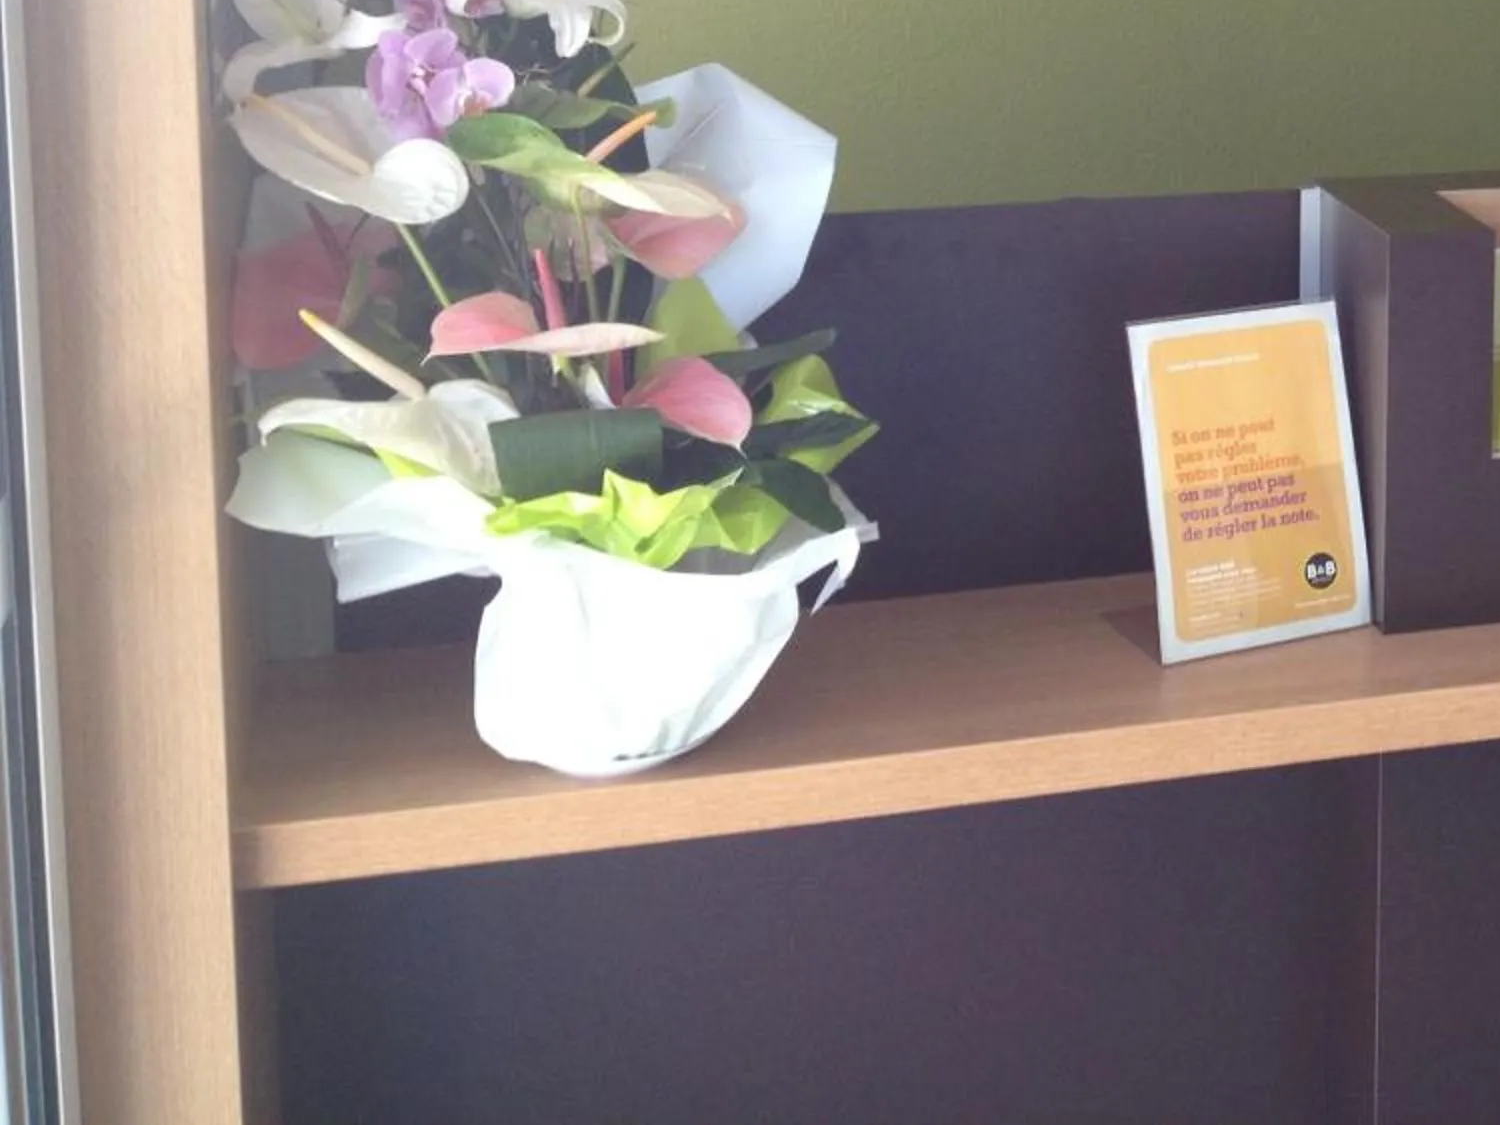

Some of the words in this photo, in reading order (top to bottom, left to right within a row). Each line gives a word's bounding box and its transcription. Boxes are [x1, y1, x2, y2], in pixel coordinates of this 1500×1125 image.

[1172, 430, 1187, 446] Si
[1190, 430, 1211, 443] on
[1216, 426, 1235, 439] ne
[1174, 450, 1204, 469] pas
[1178, 490, 1200, 503] on
[1203, 486, 1224, 500] ne
[1226, 477, 1264, 502] peut
[1267, 473, 1295, 493] pas
[1180, 507, 1219, 523] vous
[1223, 490, 1308, 515] demander
[1182, 526, 1203, 542] de
[1207, 518, 1257, 539] régler
[1261, 513, 1277, 529] la
[1306, 560, 1336, 578] B&B
